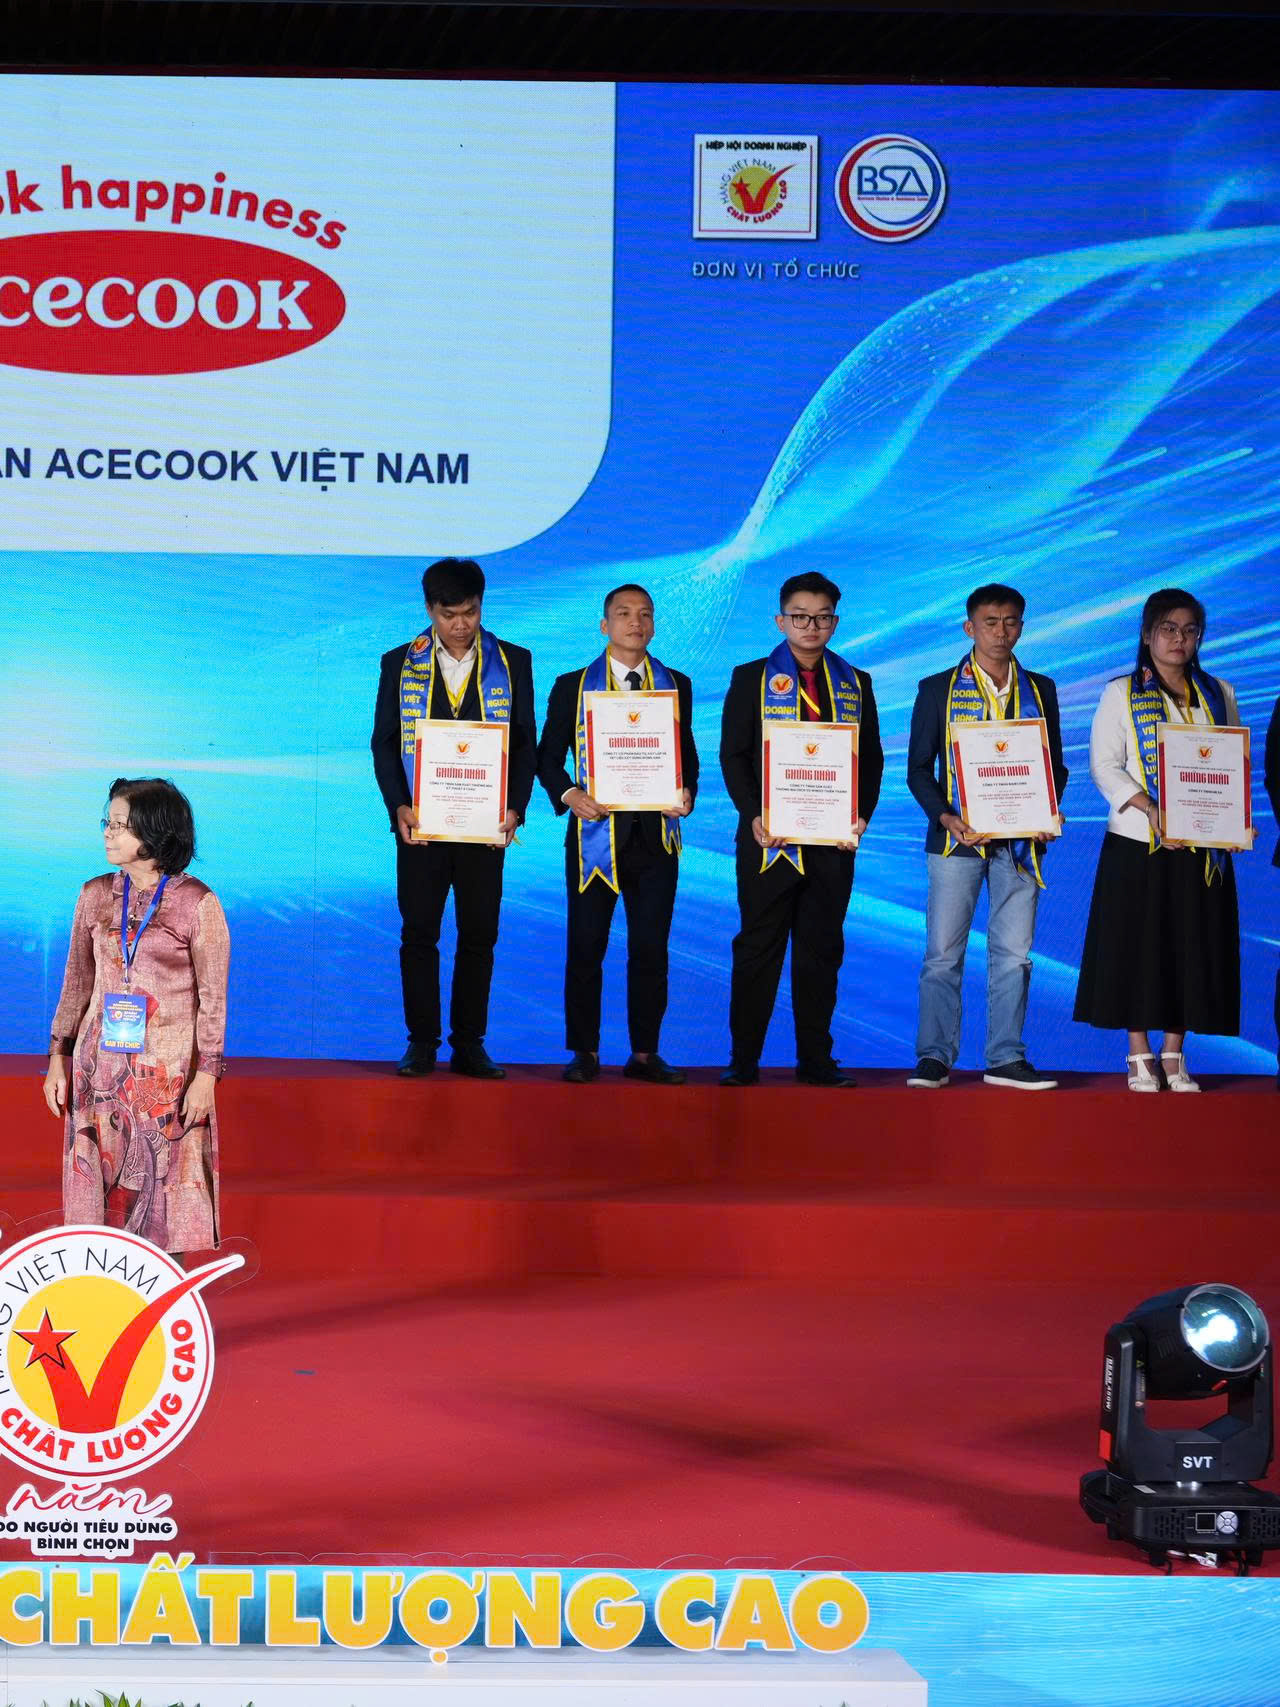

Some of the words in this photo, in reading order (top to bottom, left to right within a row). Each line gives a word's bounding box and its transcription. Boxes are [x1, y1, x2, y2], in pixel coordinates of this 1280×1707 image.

[856, 165, 930, 196] BSA
[61, 165, 348, 250] happiness
[692, 261, 736, 278] ĐƠN
[806, 260, 860, 278] CHỨC
[44, 446, 261, 483] ACECOOK
[269, 448, 365, 493] VIỆT
[375, 450, 471, 485] NAM
[1143, 740, 1155, 750] NA
[5, 1247, 68, 1295] VIỆT
[83, 1246, 162, 1295] NAM
[1, 1406, 75, 1463] CHẤT
[86, 1392, 183, 1463] LƯỢNG
[169, 1318, 197, 1383] CAO
[1182, 1456, 1213, 1469] SVT
[12, 1483, 168, 1515] năm
[23, 1518, 78, 1534] NGƯỜI
[84, 1518, 119, 1534] TIÊU
[124, 1518, 173, 1534] DÙNG
[37, 1535, 77, 1549] BÌNH
[83, 1538, 129, 1553] CHỌN
[265, 1567, 647, 1666] LƯỢNG
[654, 1573, 871, 1654] CAO
